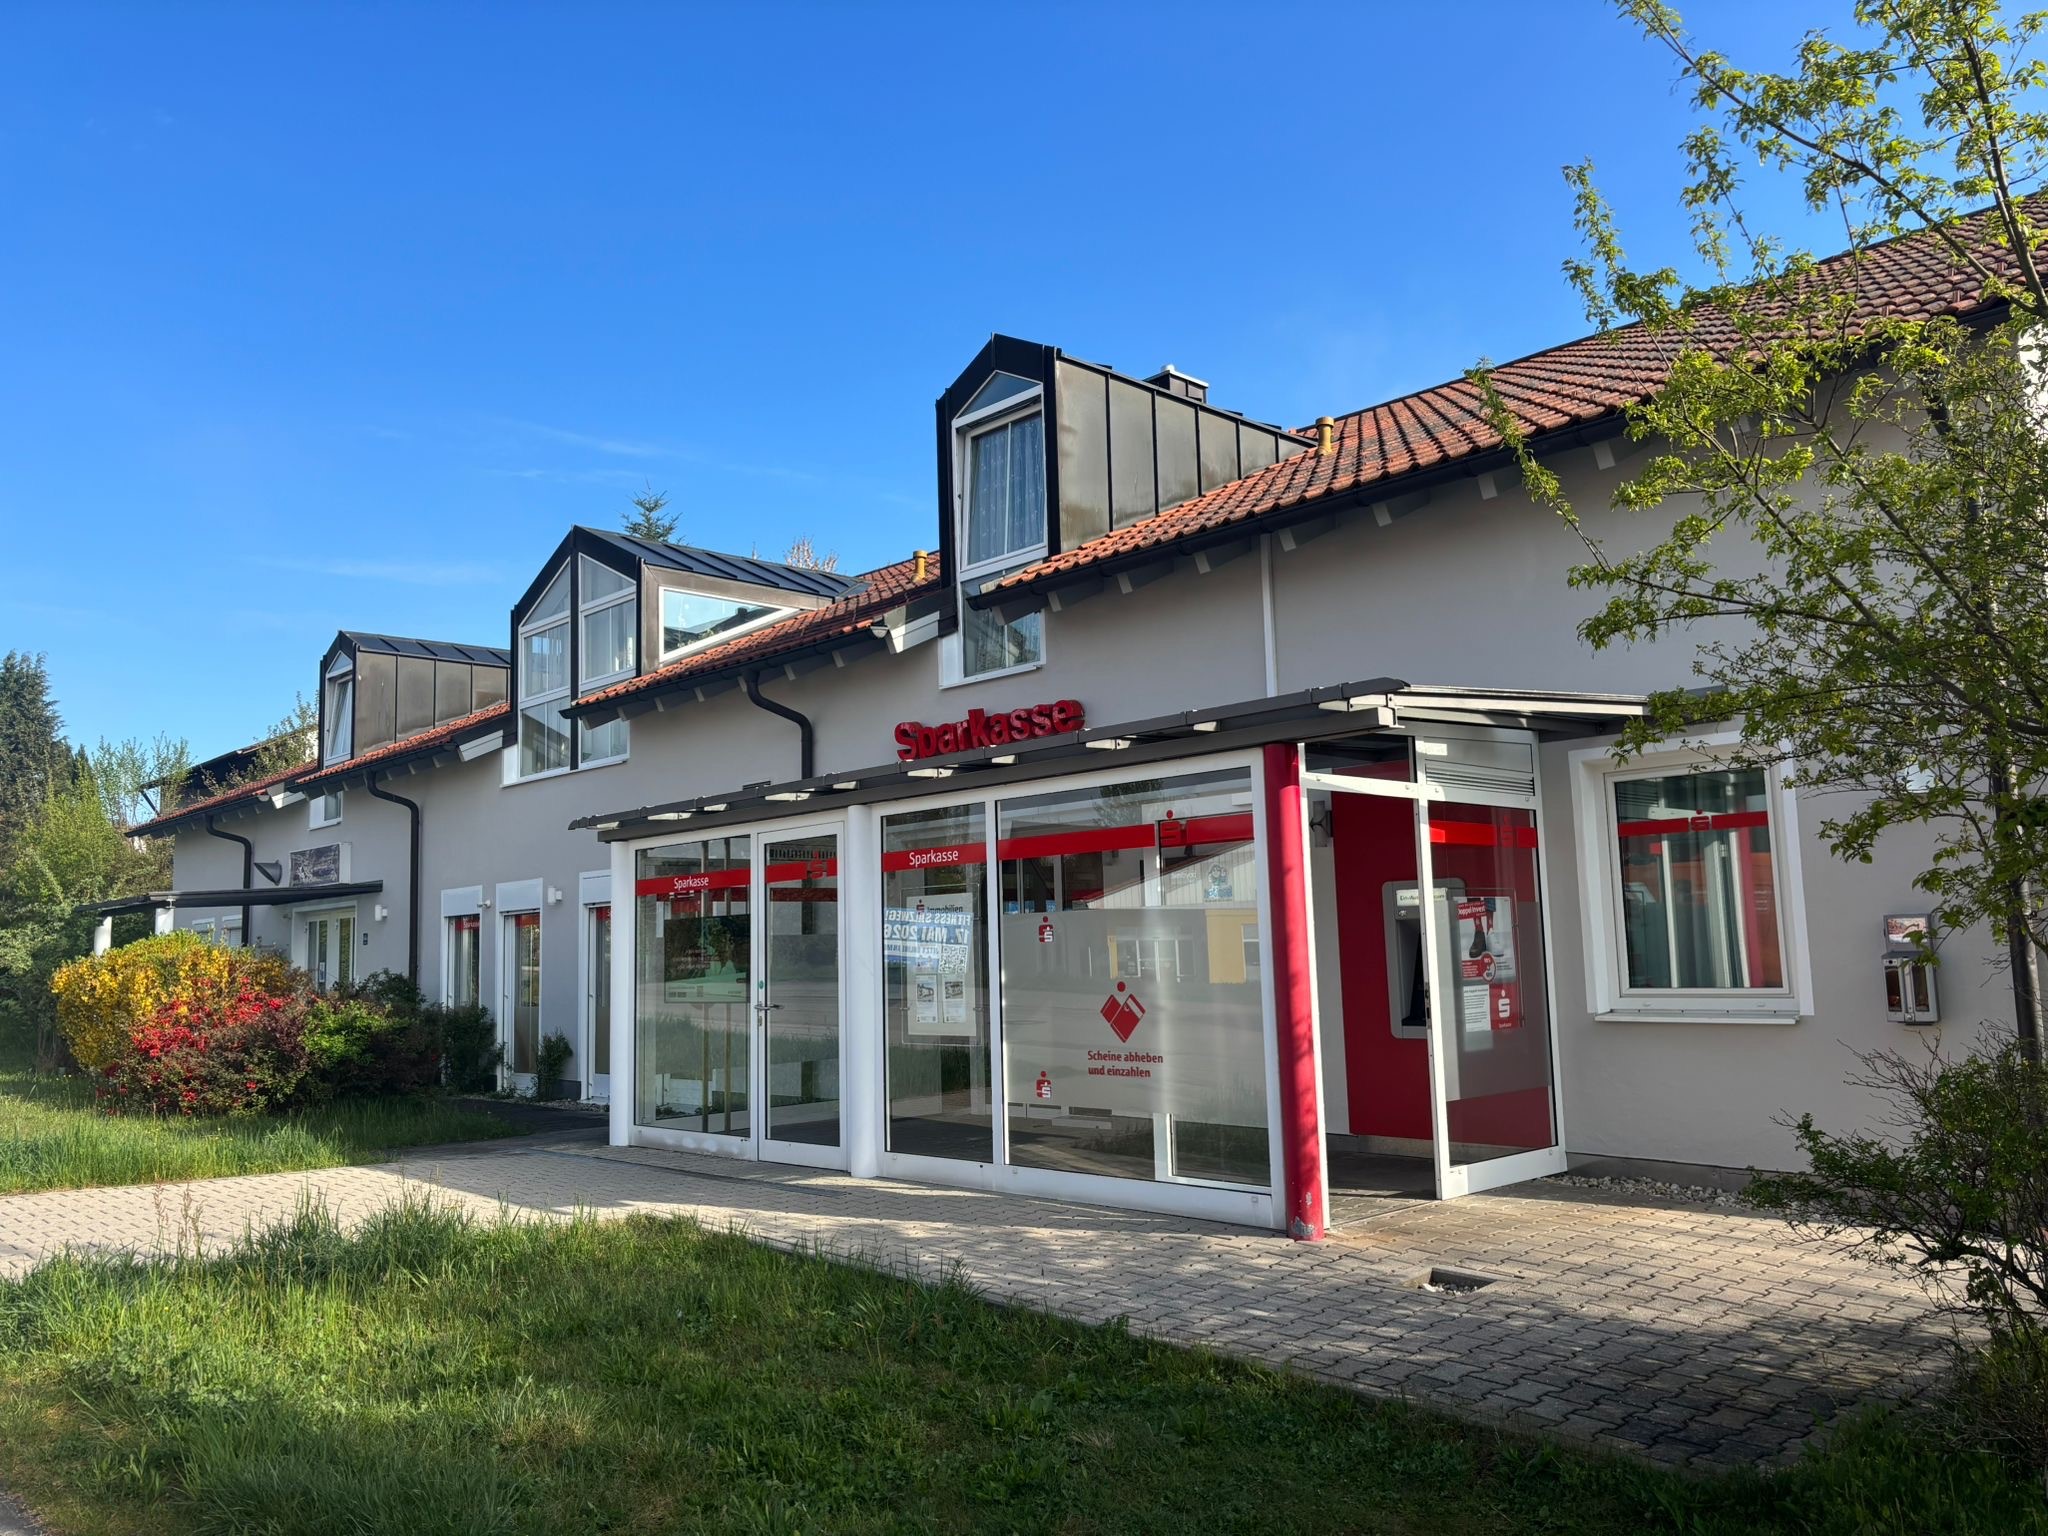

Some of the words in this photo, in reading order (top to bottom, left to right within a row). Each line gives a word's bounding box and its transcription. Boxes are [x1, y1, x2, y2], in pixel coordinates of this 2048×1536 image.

[894, 700, 1085, 761] Sparkasse
[909, 849, 959, 868] Sparkasse
[674, 876, 709, 891] Sparkasse
[1087, 1050, 1122, 1062] Scheine
[1123, 1051, 1163, 1063] abheben
[1088, 1065, 1105, 1076] und
[1107, 1065, 1151, 1077] einzahlen
